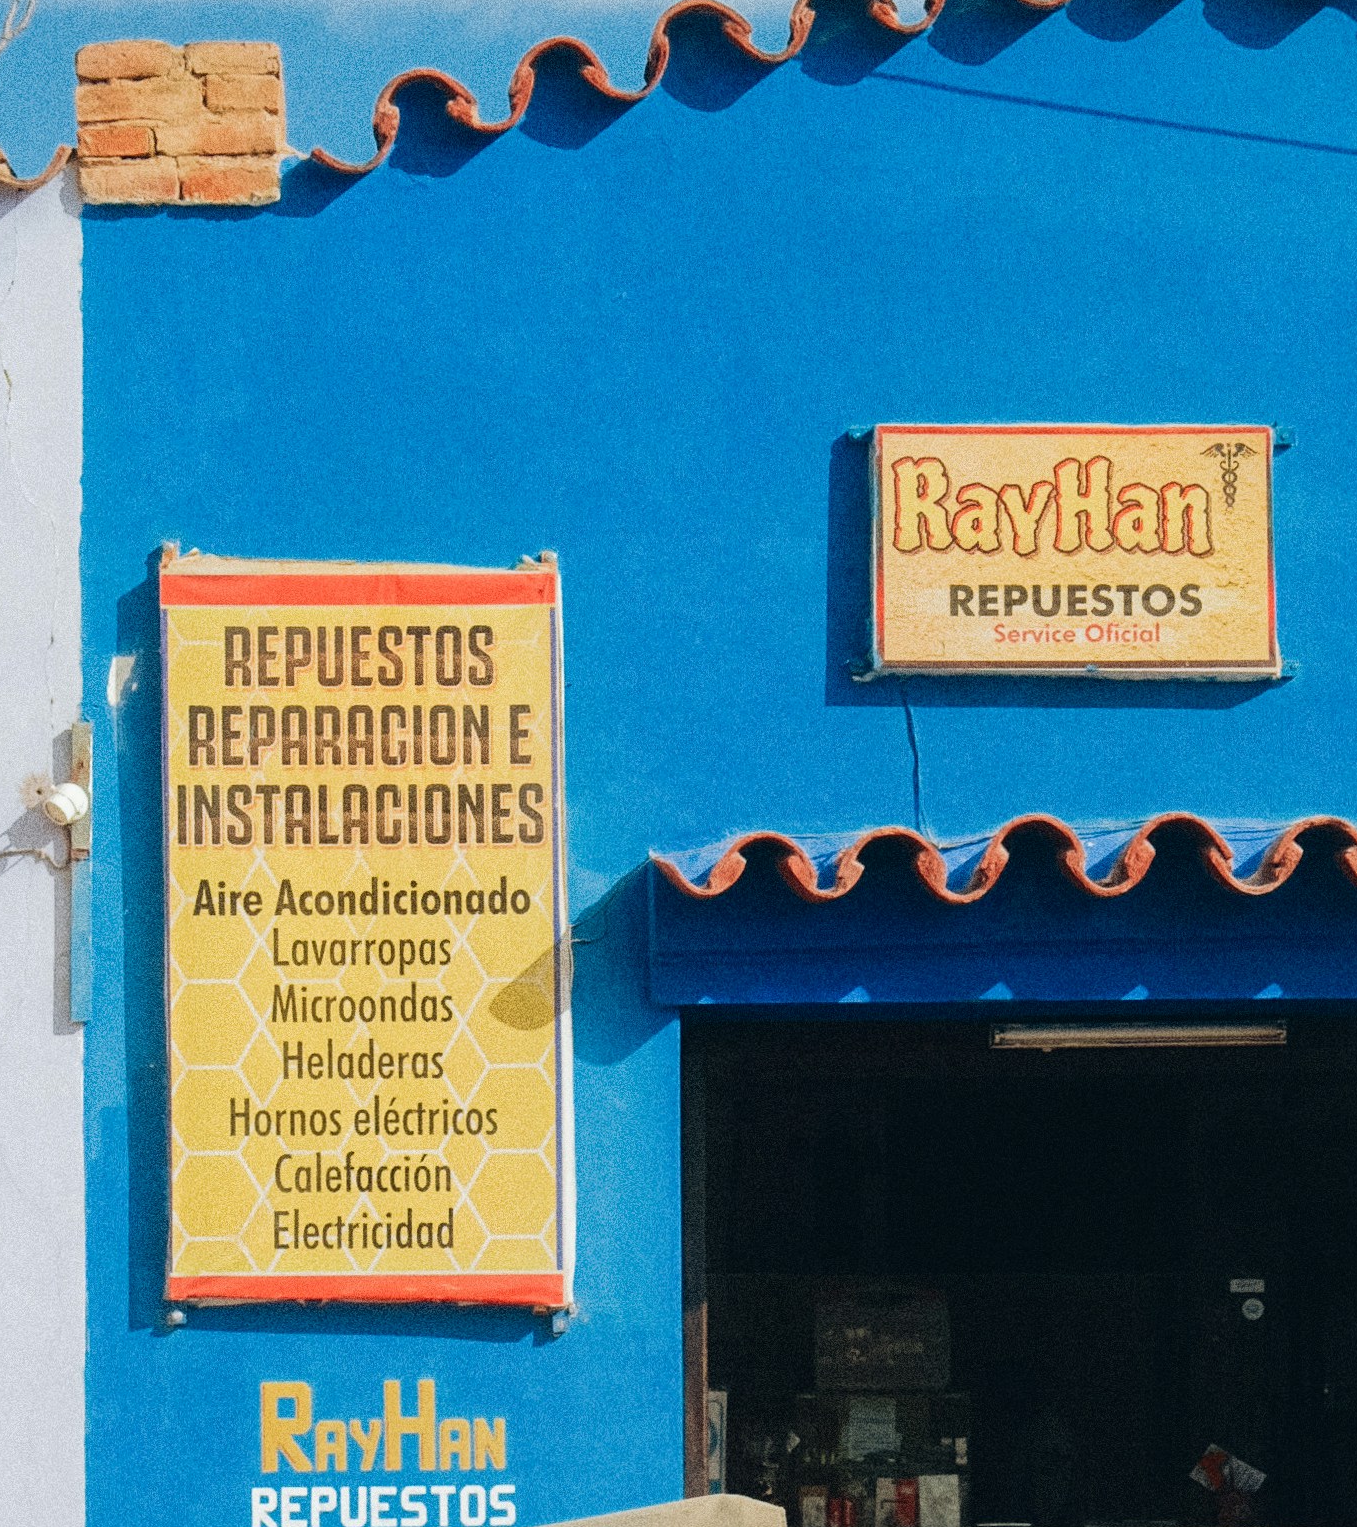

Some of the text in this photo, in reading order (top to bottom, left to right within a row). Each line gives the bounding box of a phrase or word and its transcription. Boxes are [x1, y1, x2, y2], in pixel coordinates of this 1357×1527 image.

[891, 455, 1213, 557] RayHan
[949, 583, 1203, 617] REPUESTOS
[994, 622, 1161, 644] Service Oficial
[224, 625, 496, 687] REPUESTOS
[188, 704, 533, 766] REPARACION E
[177, 783, 545, 846] INSTALACIONES
[193, 876, 532, 917] Aire Acondicionado
[271, 926, 452, 975] Lavarropas
[271, 982, 454, 1025] Microondas
[282, 1039, 444, 1081] Heladeras
[228, 1094, 498, 1137] Hornos eléctricos
[274, 1152, 452, 1194] Calefacción
[273, 1209, 455, 1251] Electricidad
